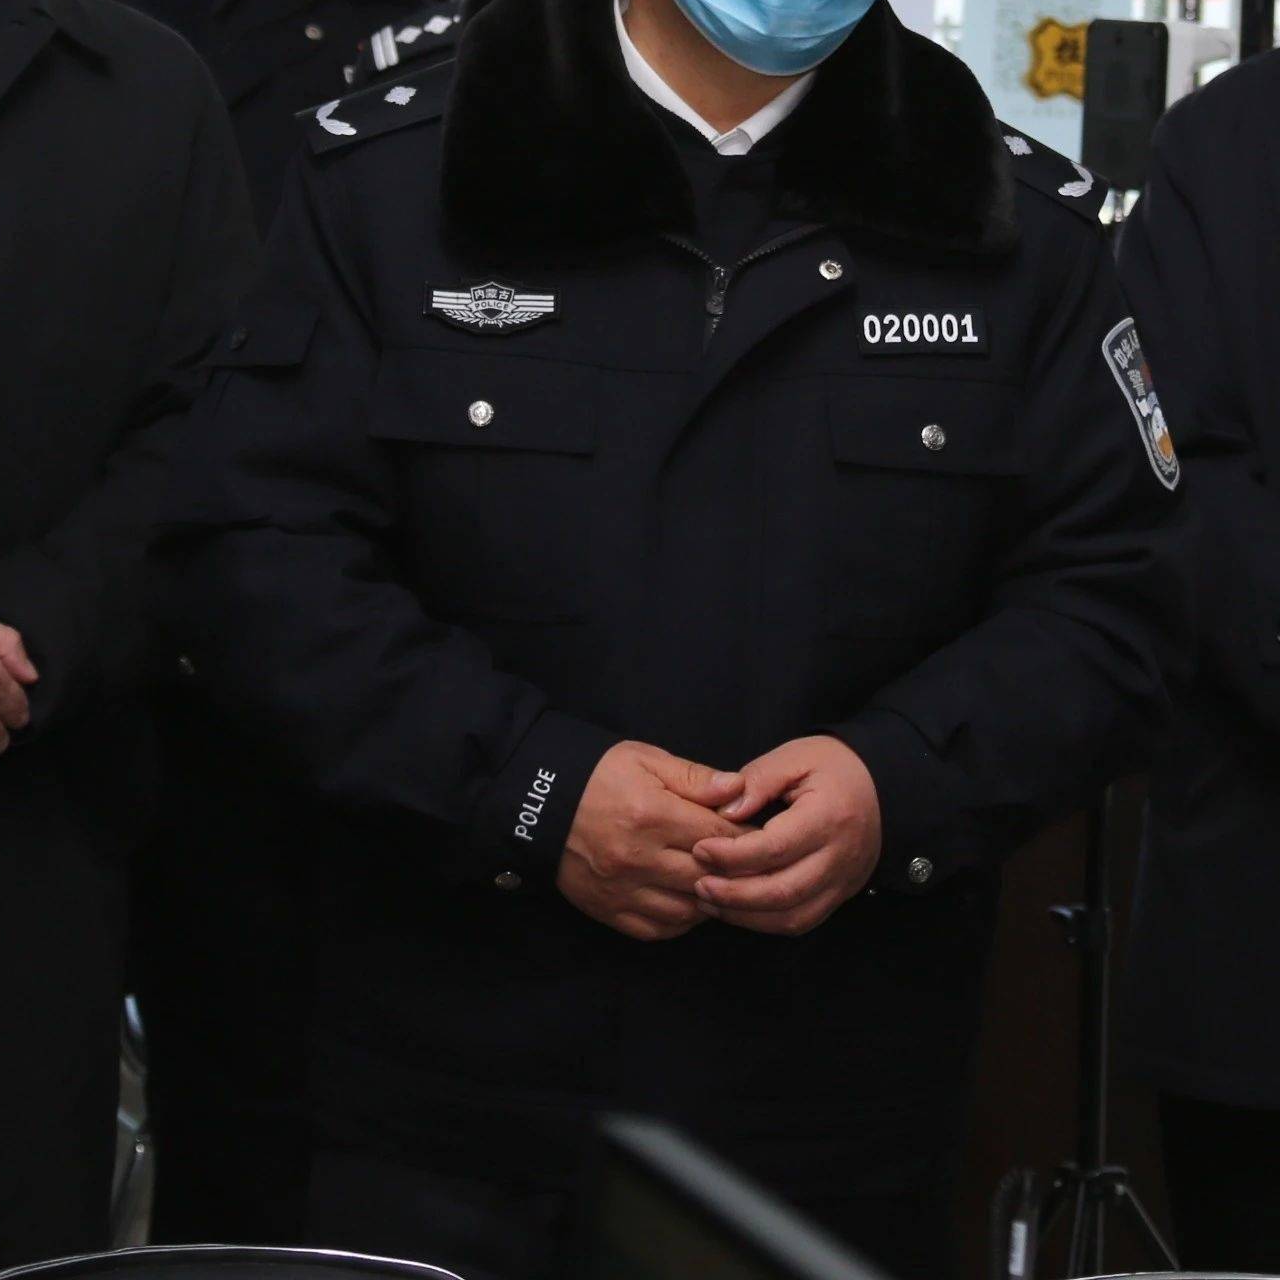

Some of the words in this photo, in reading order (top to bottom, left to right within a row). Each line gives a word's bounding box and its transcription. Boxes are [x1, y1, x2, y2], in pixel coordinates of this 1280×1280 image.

[474, 301, 510, 311] POLICE
[863, 313, 979, 343] 020001
[515, 768, 556, 841] POLICE
